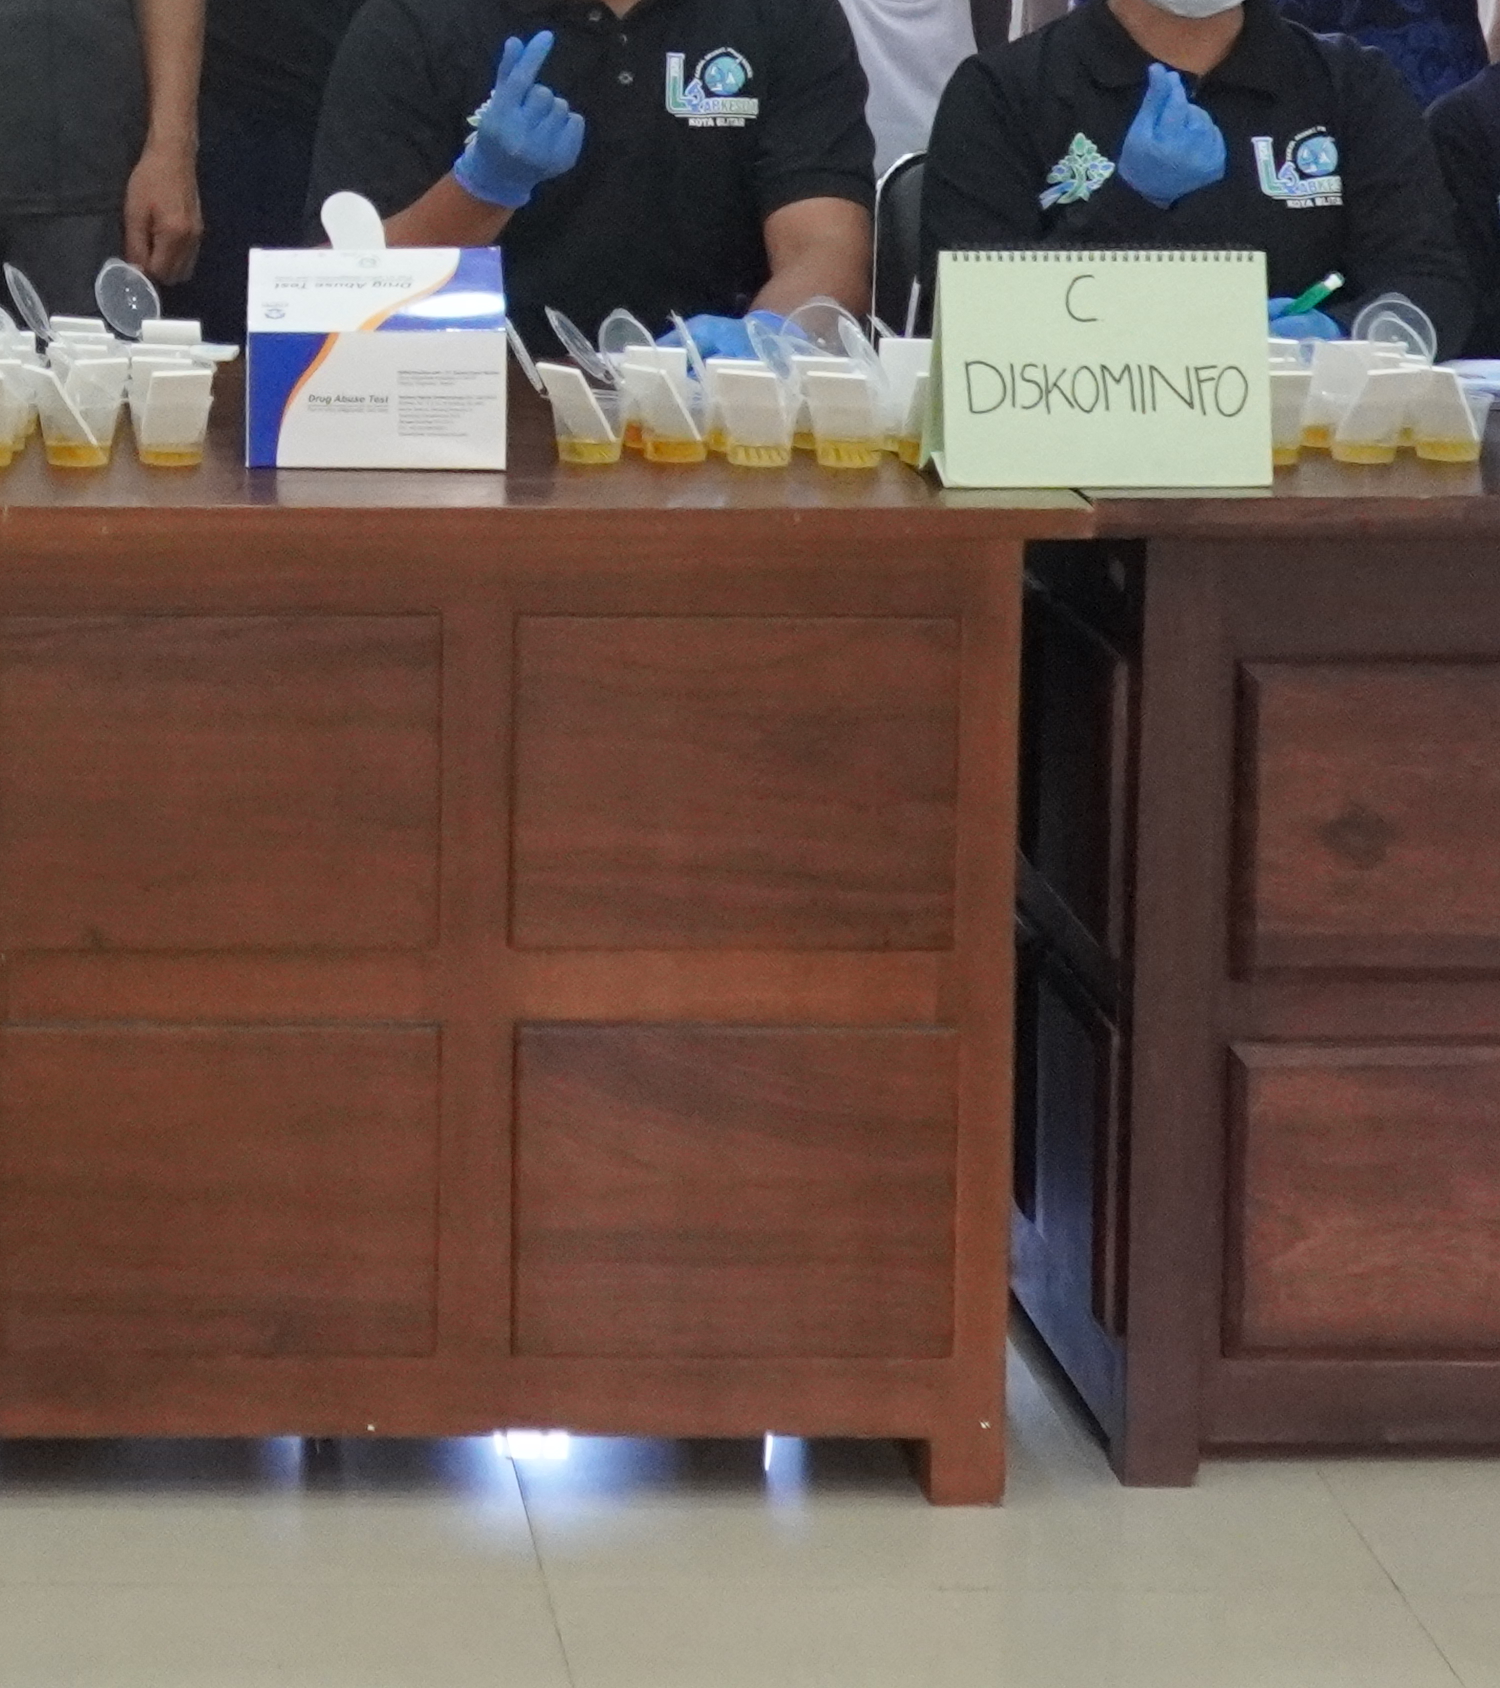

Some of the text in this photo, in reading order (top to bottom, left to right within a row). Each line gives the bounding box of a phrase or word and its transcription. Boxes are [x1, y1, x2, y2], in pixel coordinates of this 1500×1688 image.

[1065, 274, 1098, 322] C
[308, 394, 389, 405] Drug Abuse Test
[964, 360, 1249, 417] DISKOMINFO
